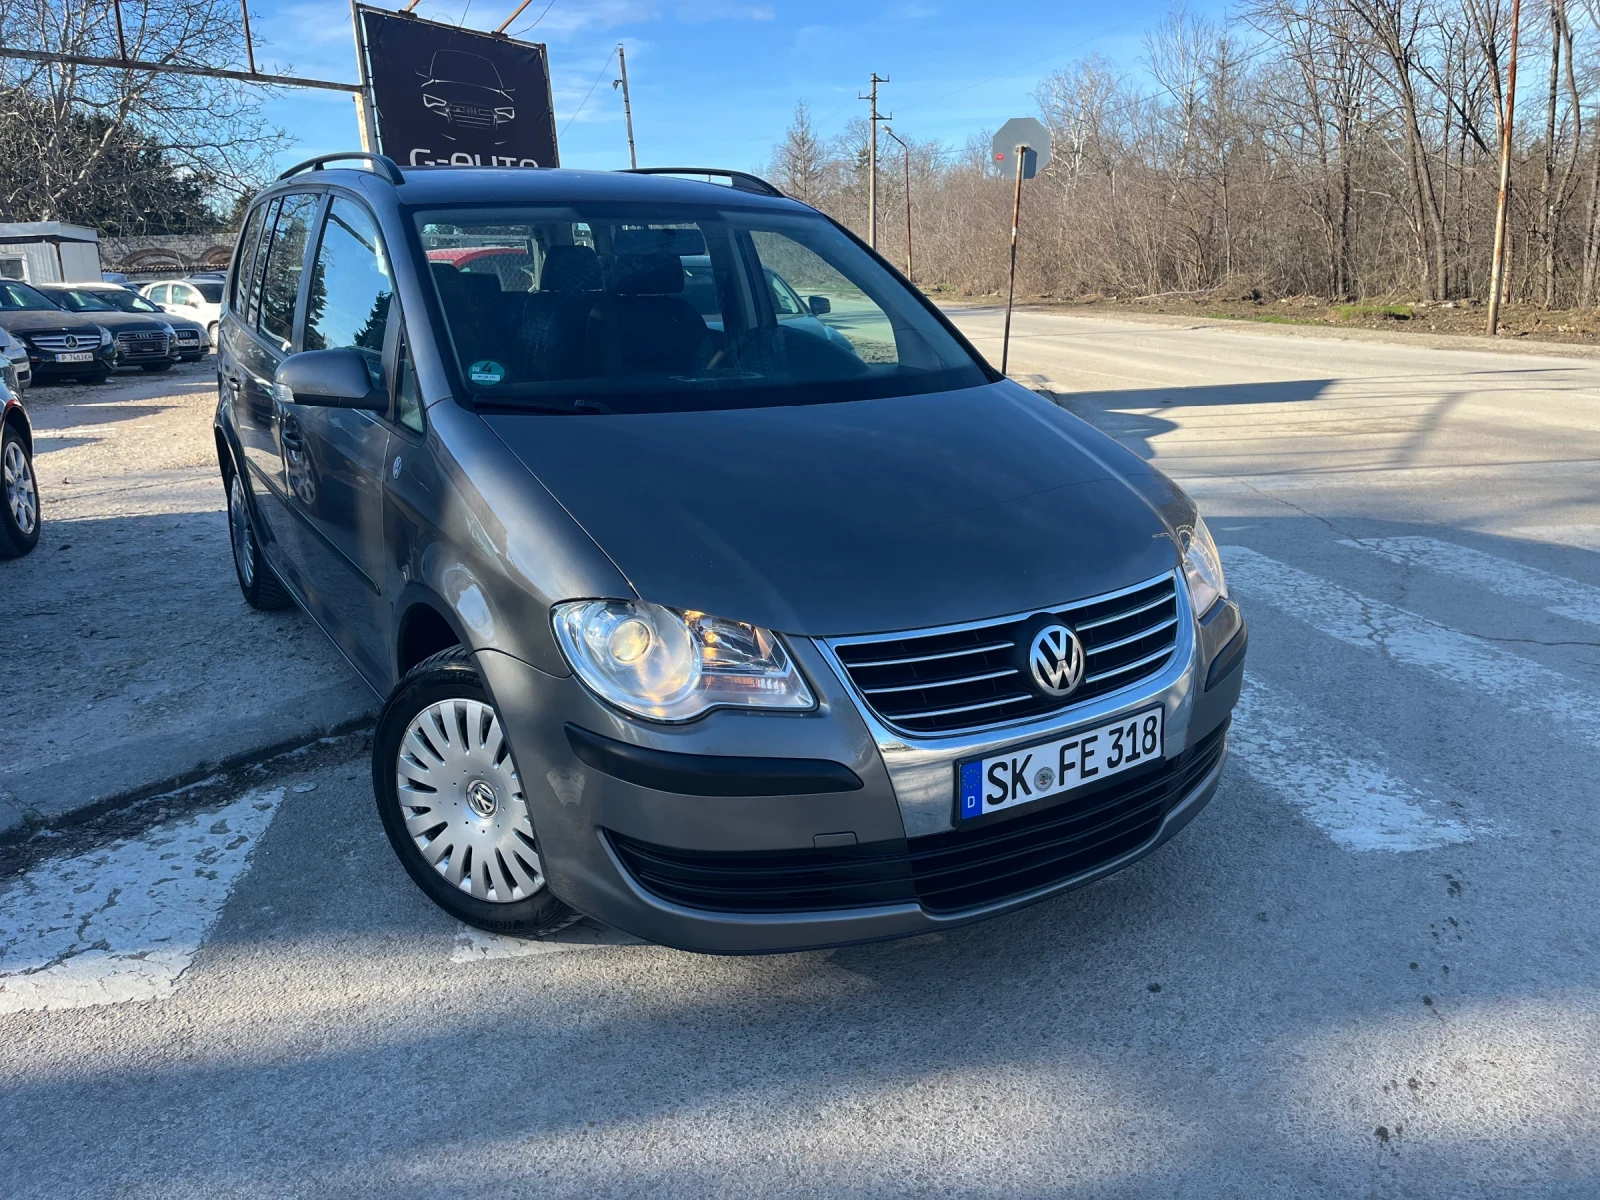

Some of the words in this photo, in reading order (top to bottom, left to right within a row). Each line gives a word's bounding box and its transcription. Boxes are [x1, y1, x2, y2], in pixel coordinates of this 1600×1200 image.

[481, 362, 492, 373] 4
[986, 754, 1033, 805] SK
[1059, 735, 1099, 786] FE
[1107, 715, 1158, 769] 318
[967, 795, 975, 808] D
